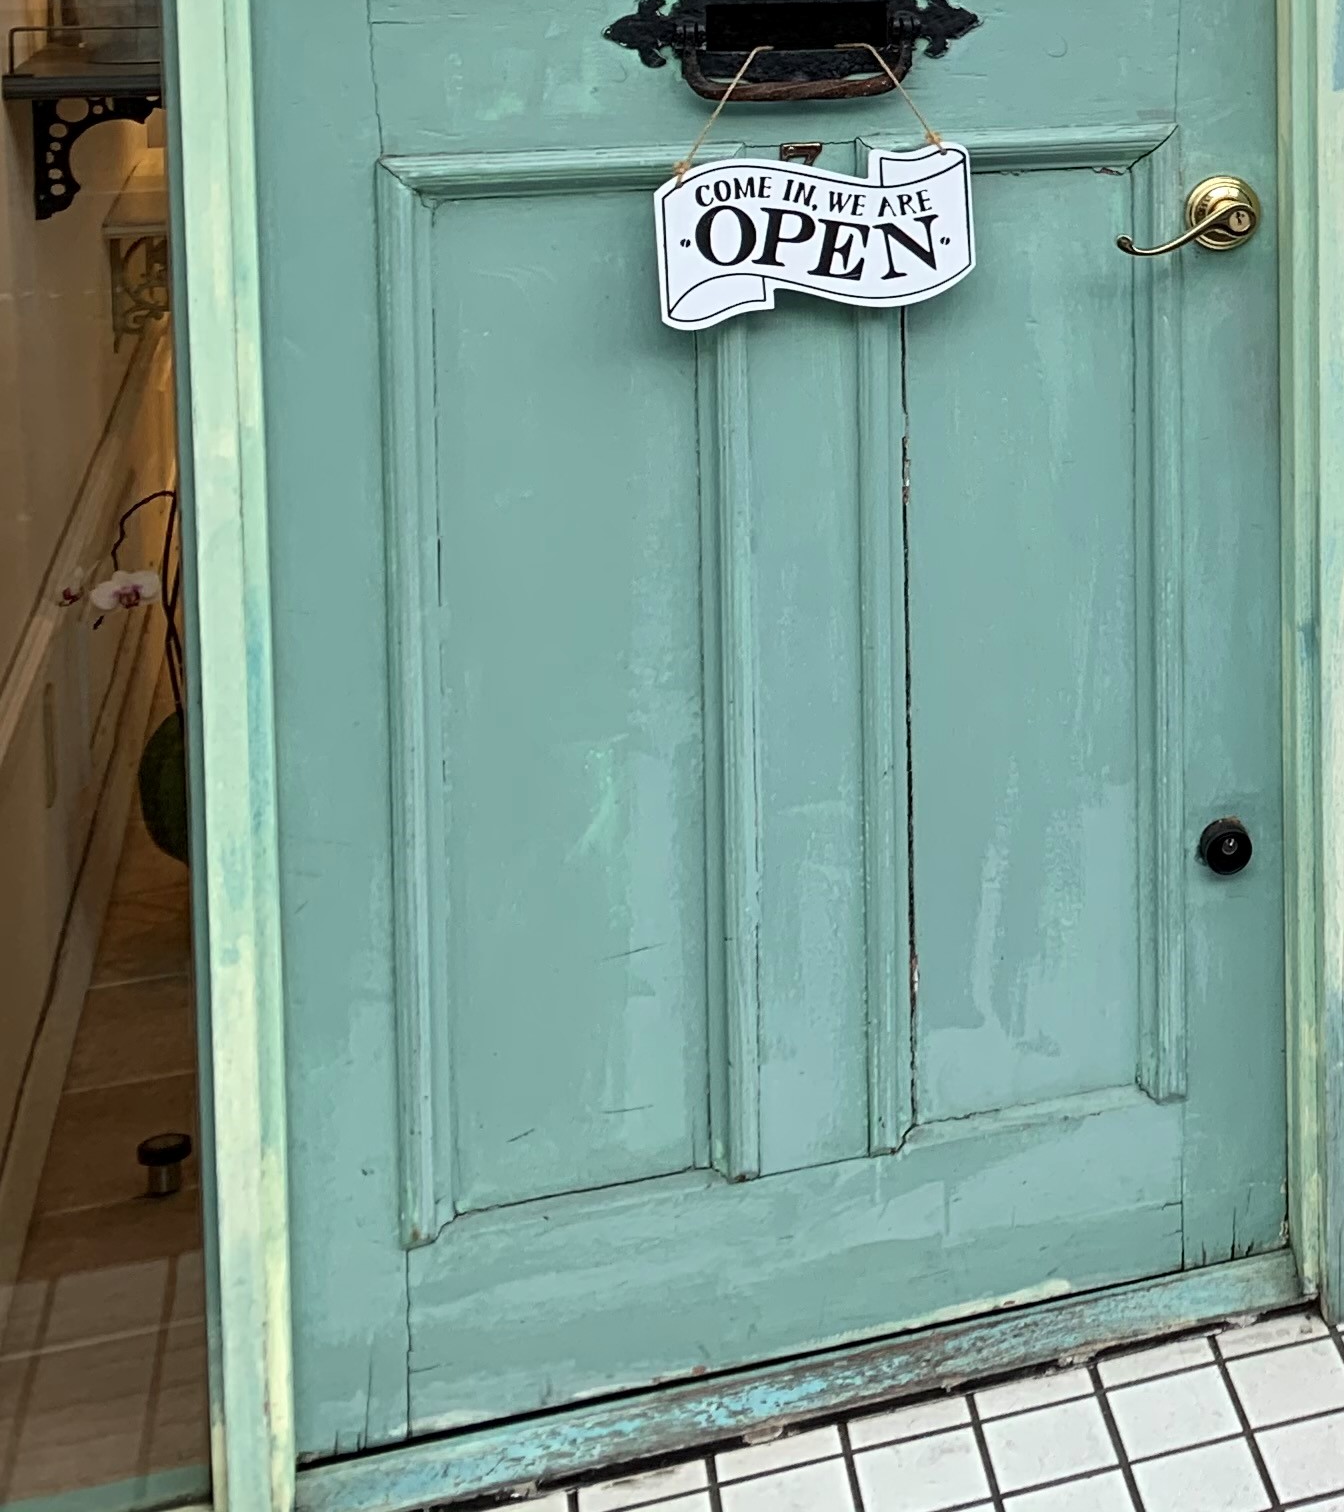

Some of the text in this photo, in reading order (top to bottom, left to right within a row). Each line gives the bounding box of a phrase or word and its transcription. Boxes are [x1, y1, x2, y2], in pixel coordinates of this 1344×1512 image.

[694, 176, 933, 218] COME IN, WE ARE
[694, 205, 939, 281] OPEN
